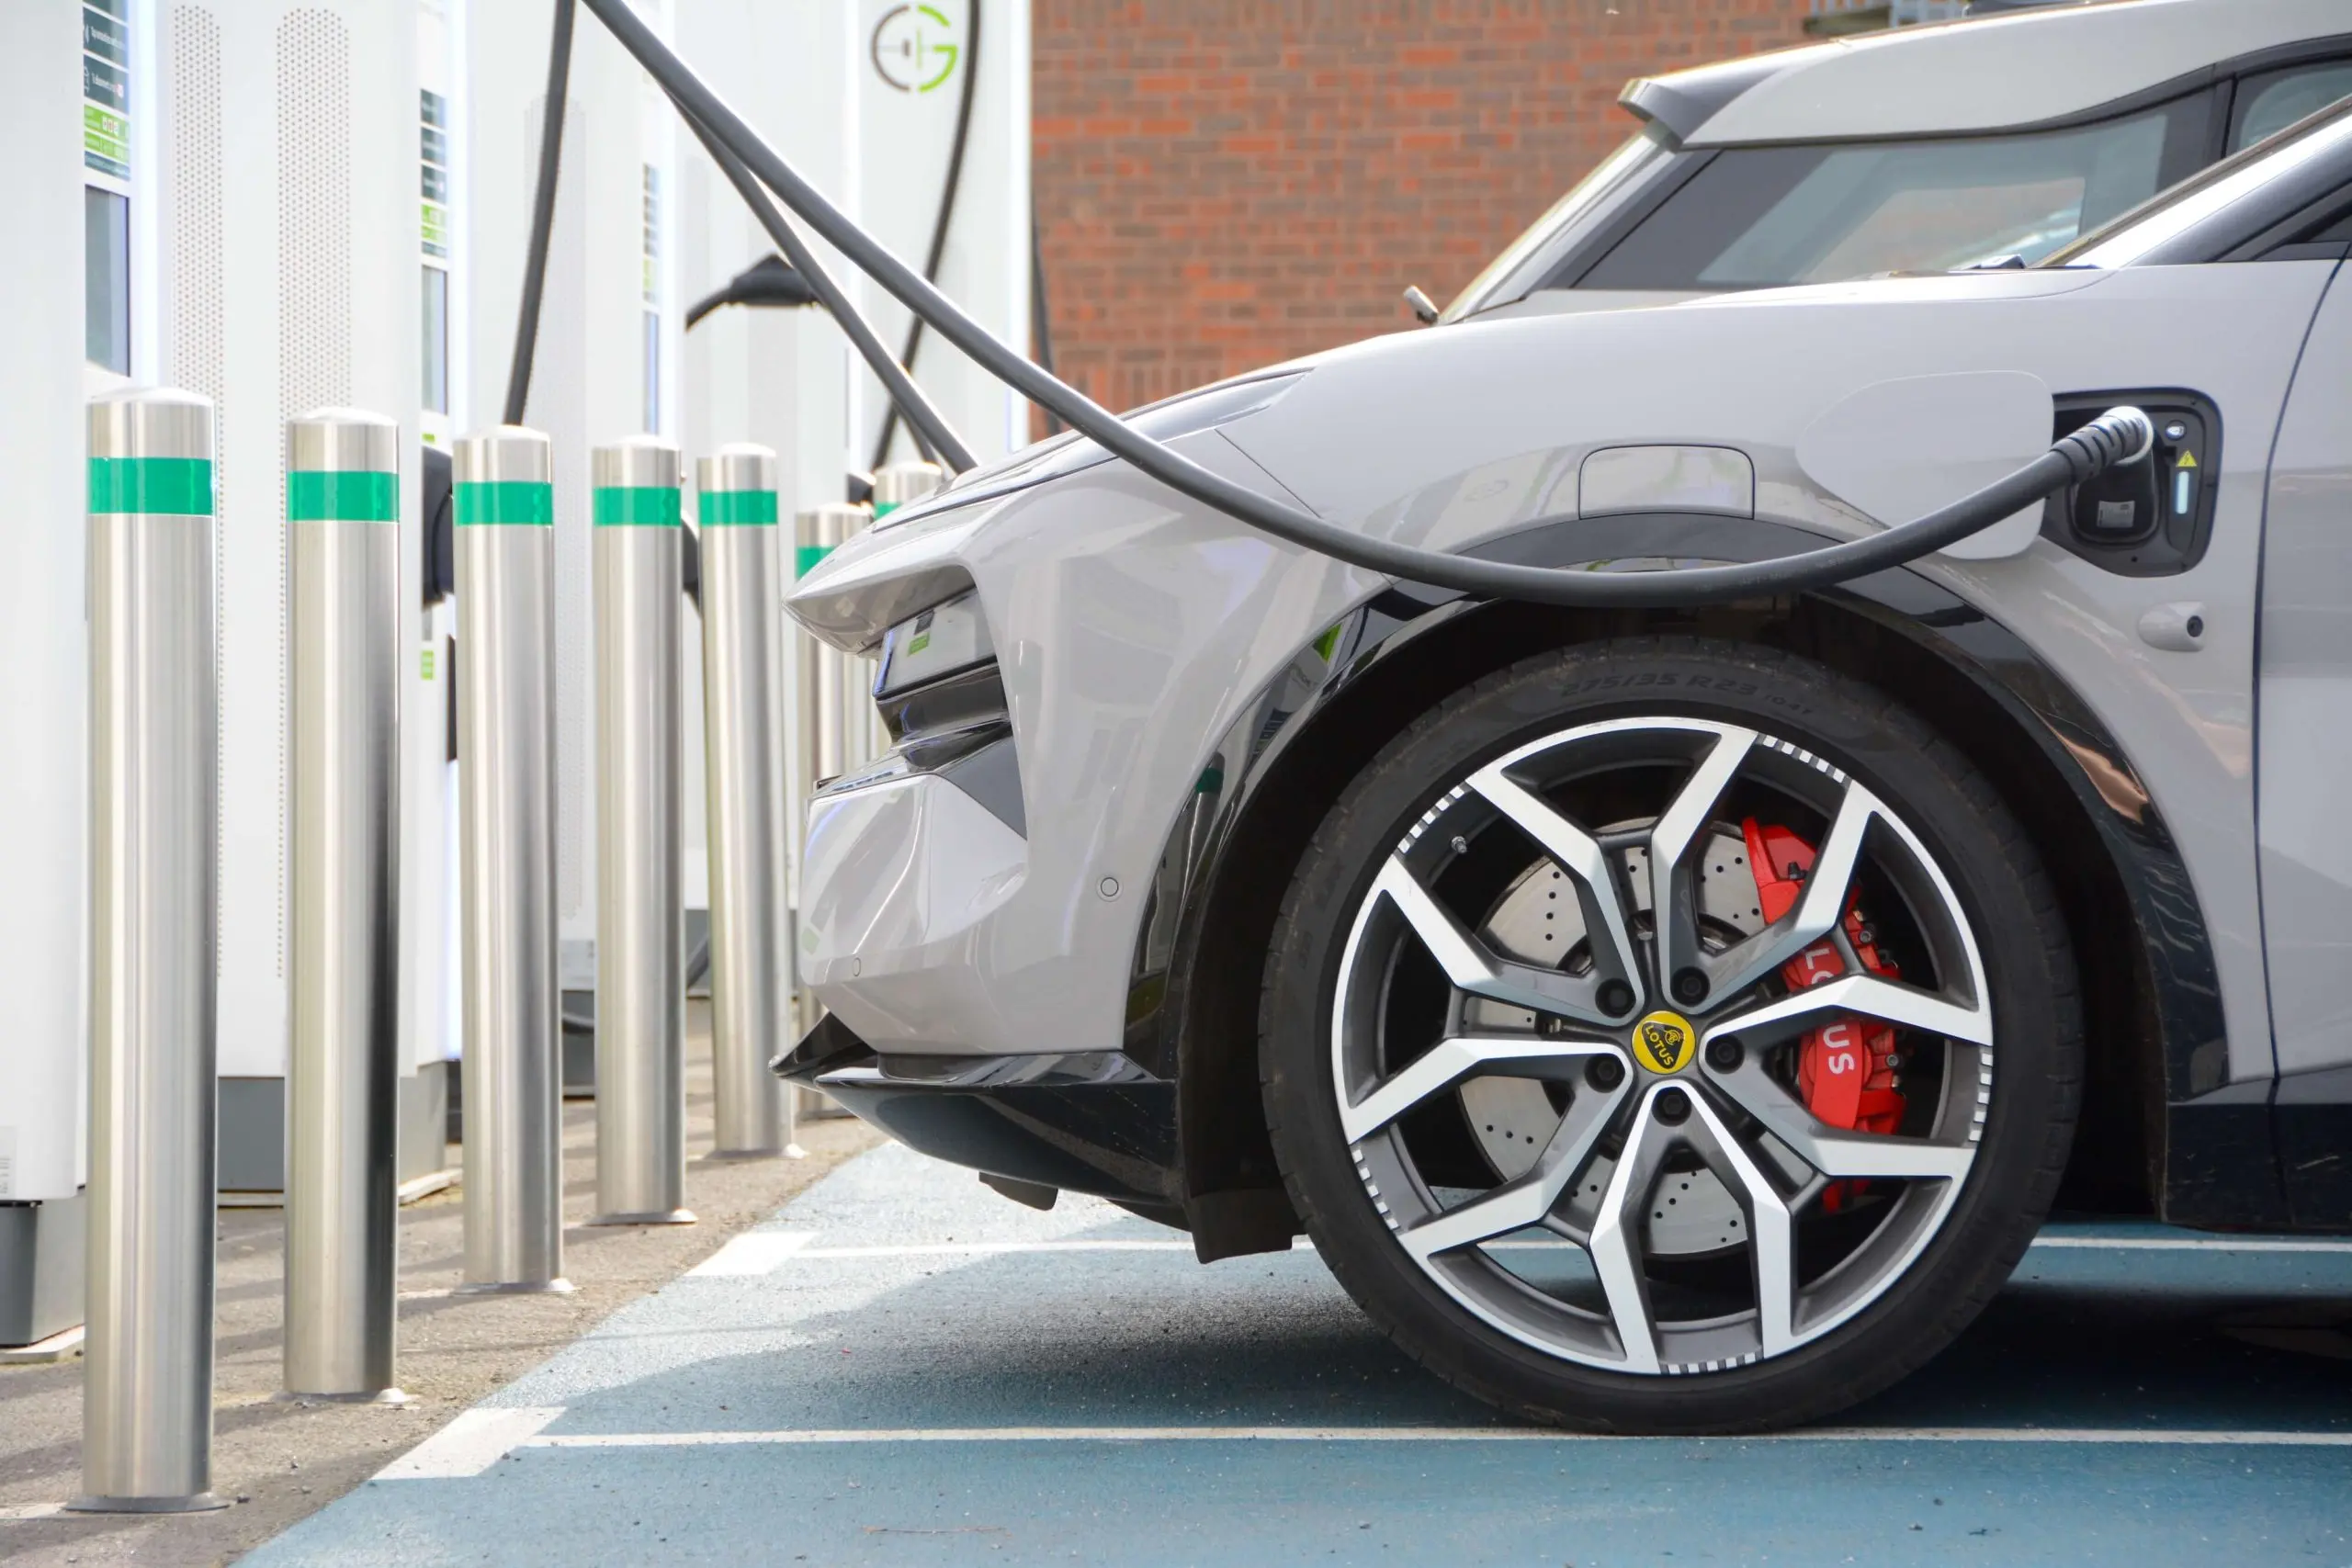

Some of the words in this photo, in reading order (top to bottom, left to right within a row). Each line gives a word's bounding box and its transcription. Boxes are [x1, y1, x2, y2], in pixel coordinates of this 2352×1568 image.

[1560, 672, 1680, 698] 275/35
[1685, 674, 1758, 696] R23
[1645, 1025, 1674, 1066] LOTUS
